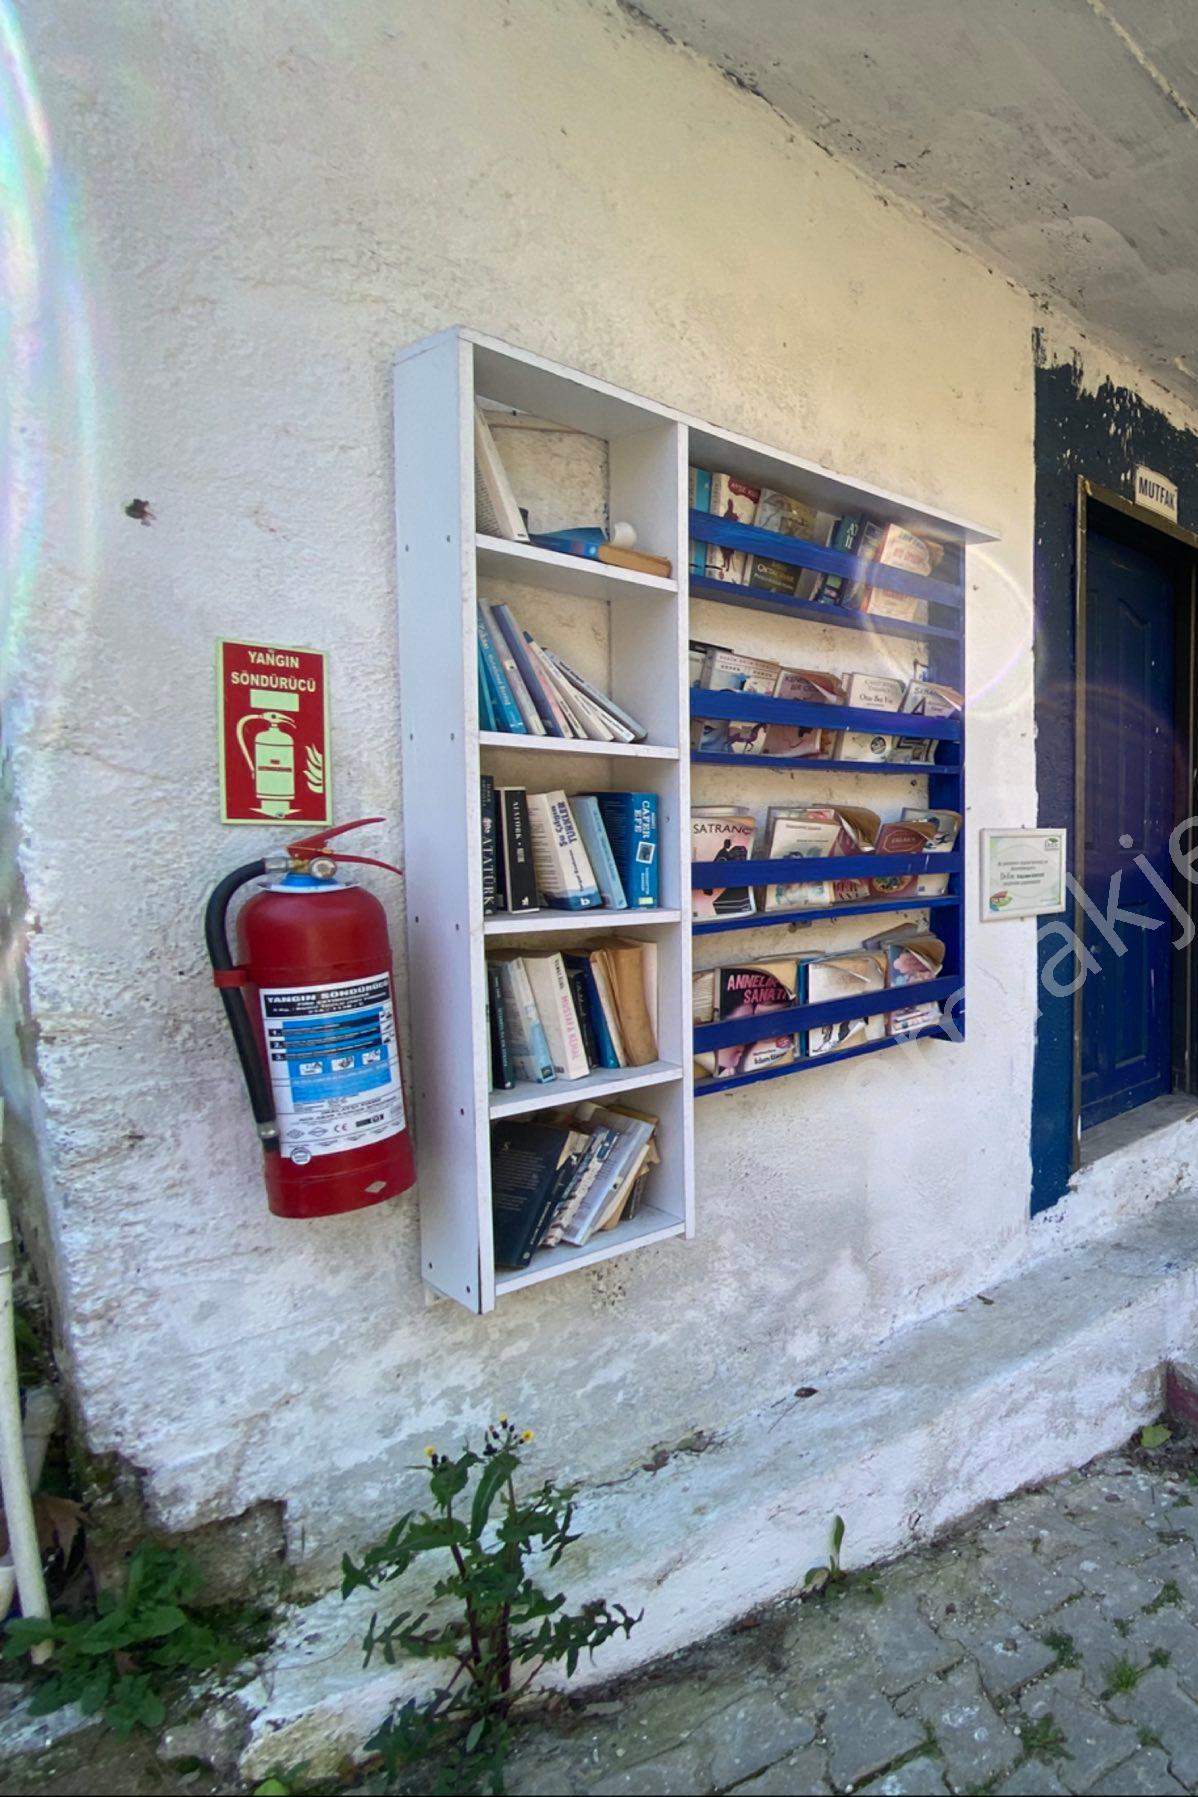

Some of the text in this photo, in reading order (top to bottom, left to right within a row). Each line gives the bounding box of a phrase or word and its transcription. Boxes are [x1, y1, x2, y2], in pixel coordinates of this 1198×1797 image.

[1139, 477, 1176, 511] MUTFAK
[248, 651, 299, 668] YANGIN
[231, 672, 316, 693] SÖNDÜRÜCÜ
[634, 809, 642, 834] EFE
[642, 800, 650, 839] CAFER
[482, 836, 496, 905] ATATÜRK
[267, 994, 316, 1005] YANGIN
